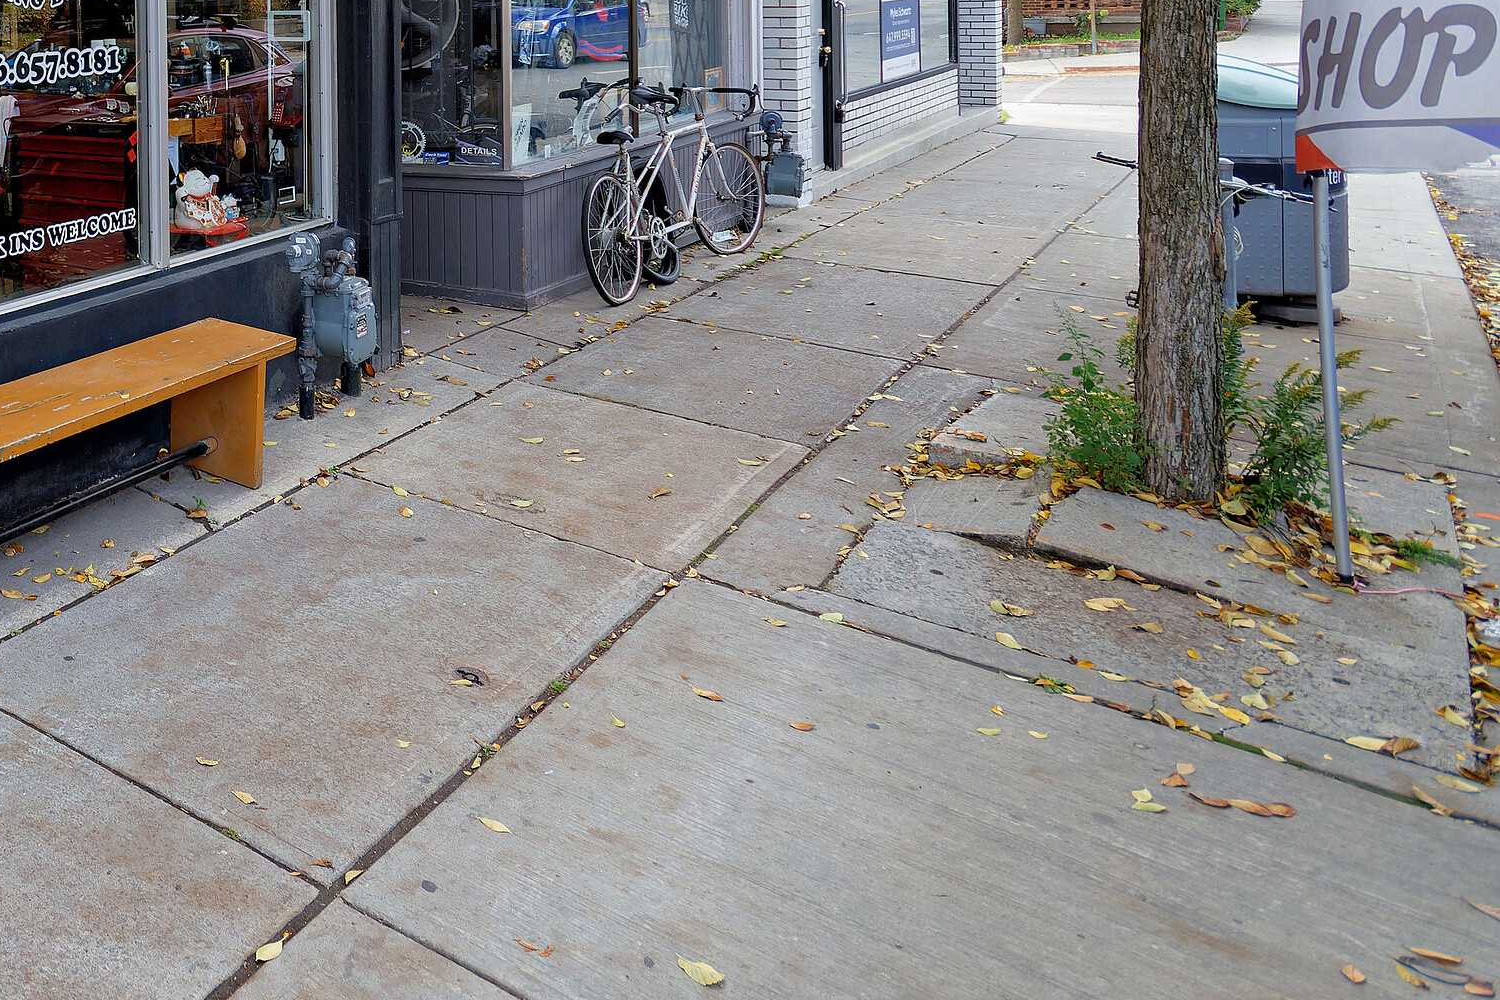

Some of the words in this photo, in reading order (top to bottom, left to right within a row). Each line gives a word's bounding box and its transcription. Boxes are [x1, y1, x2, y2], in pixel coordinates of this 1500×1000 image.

[1298, 3, 1497, 114] SHOP
[461, 147, 497, 156] DETAILS
[9, 228, 45, 256] INS
[47, 208, 136, 247] WELCOME
